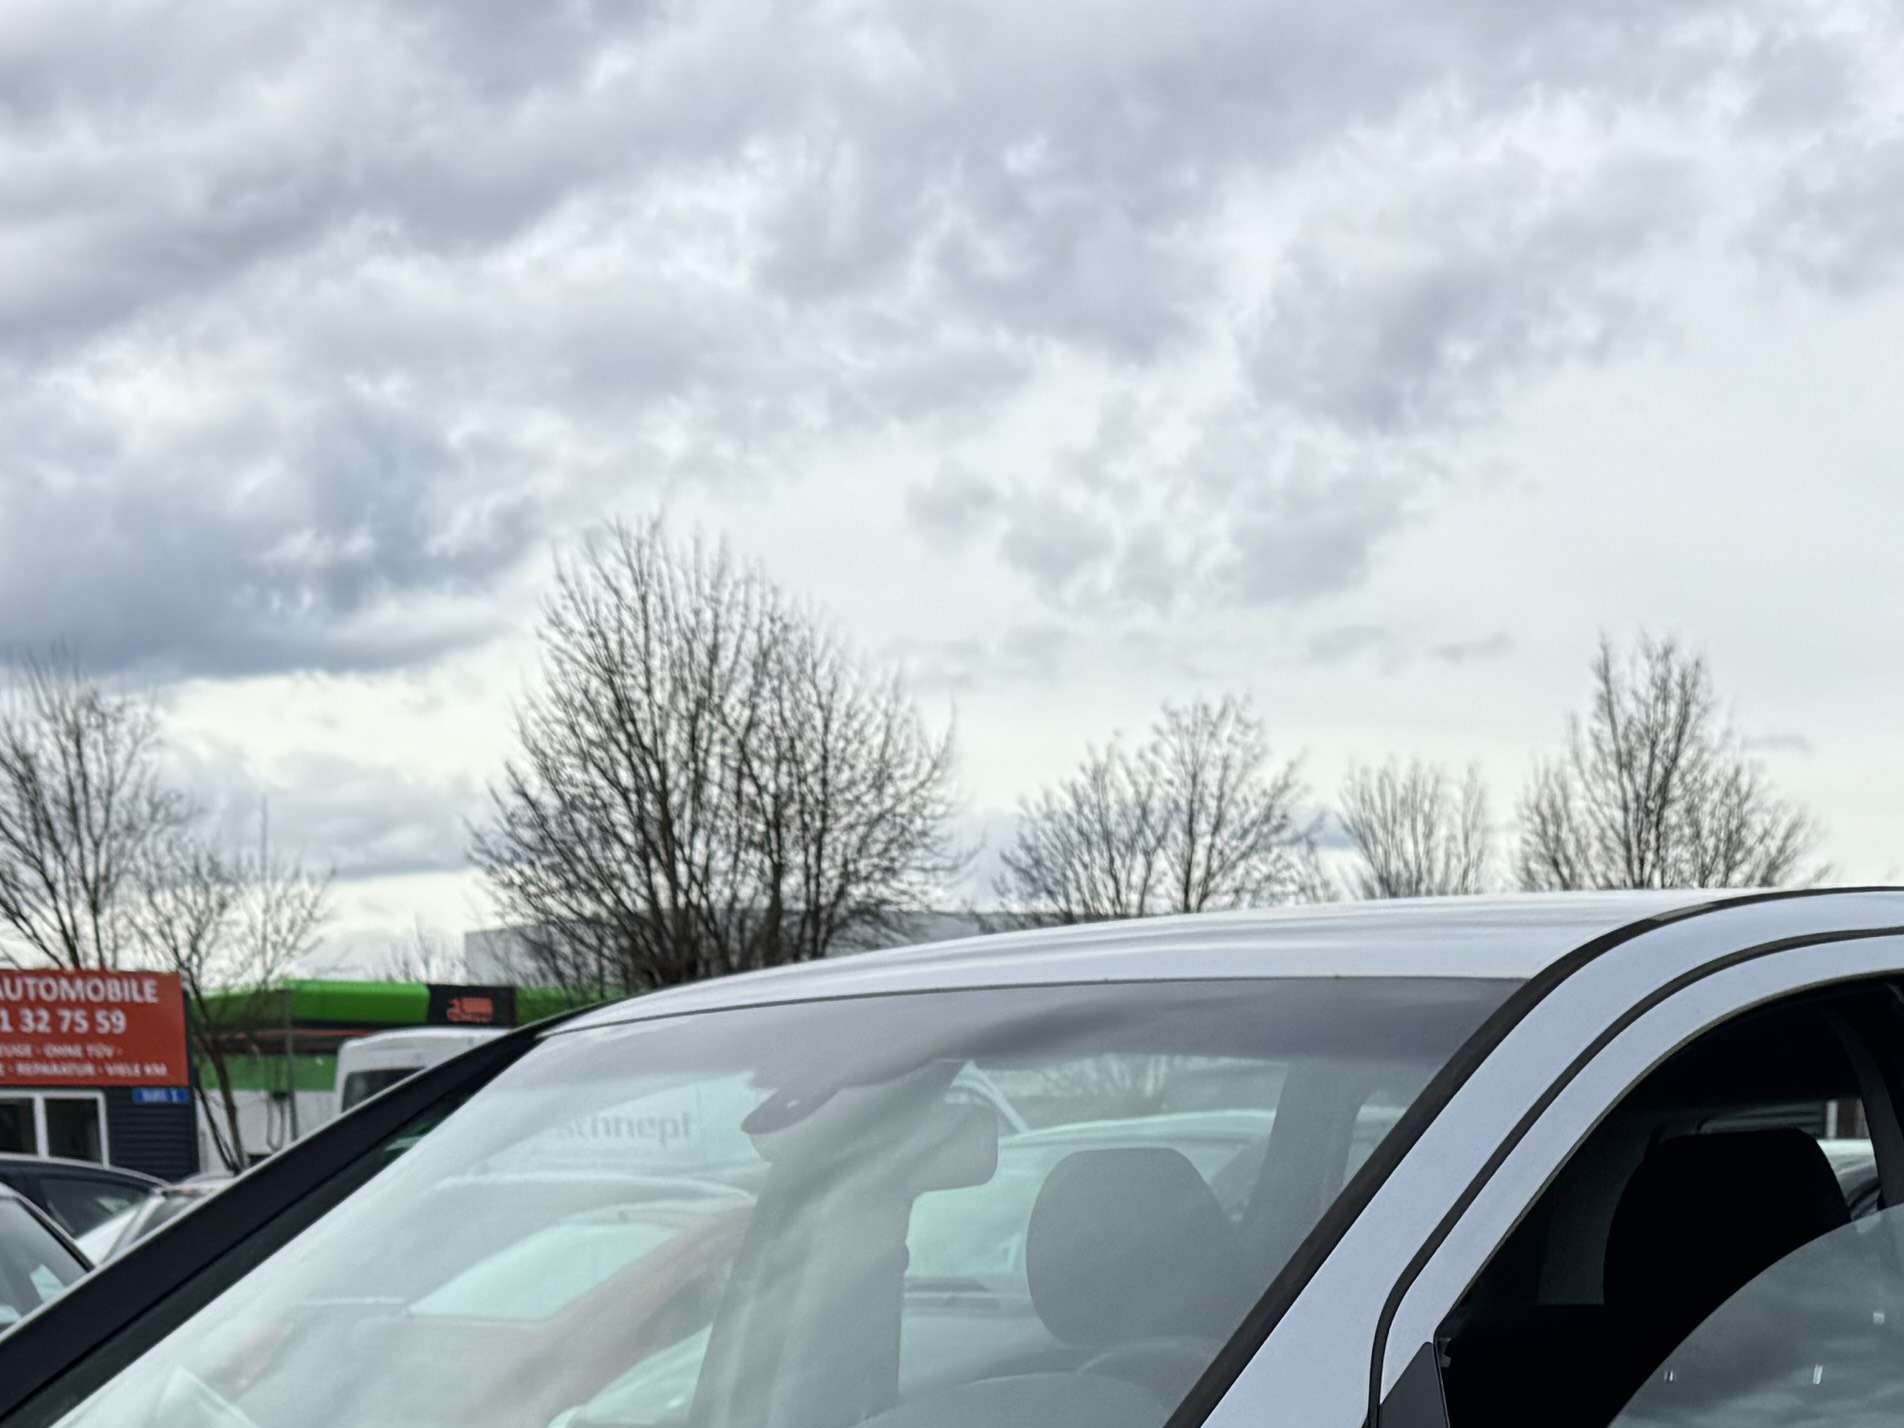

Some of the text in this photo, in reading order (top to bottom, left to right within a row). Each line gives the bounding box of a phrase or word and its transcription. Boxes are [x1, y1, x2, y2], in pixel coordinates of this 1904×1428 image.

[19, 1008, 52, 1034] 32
[57, 1009, 90, 1034] 75
[96, 1009, 128, 1035] 59
